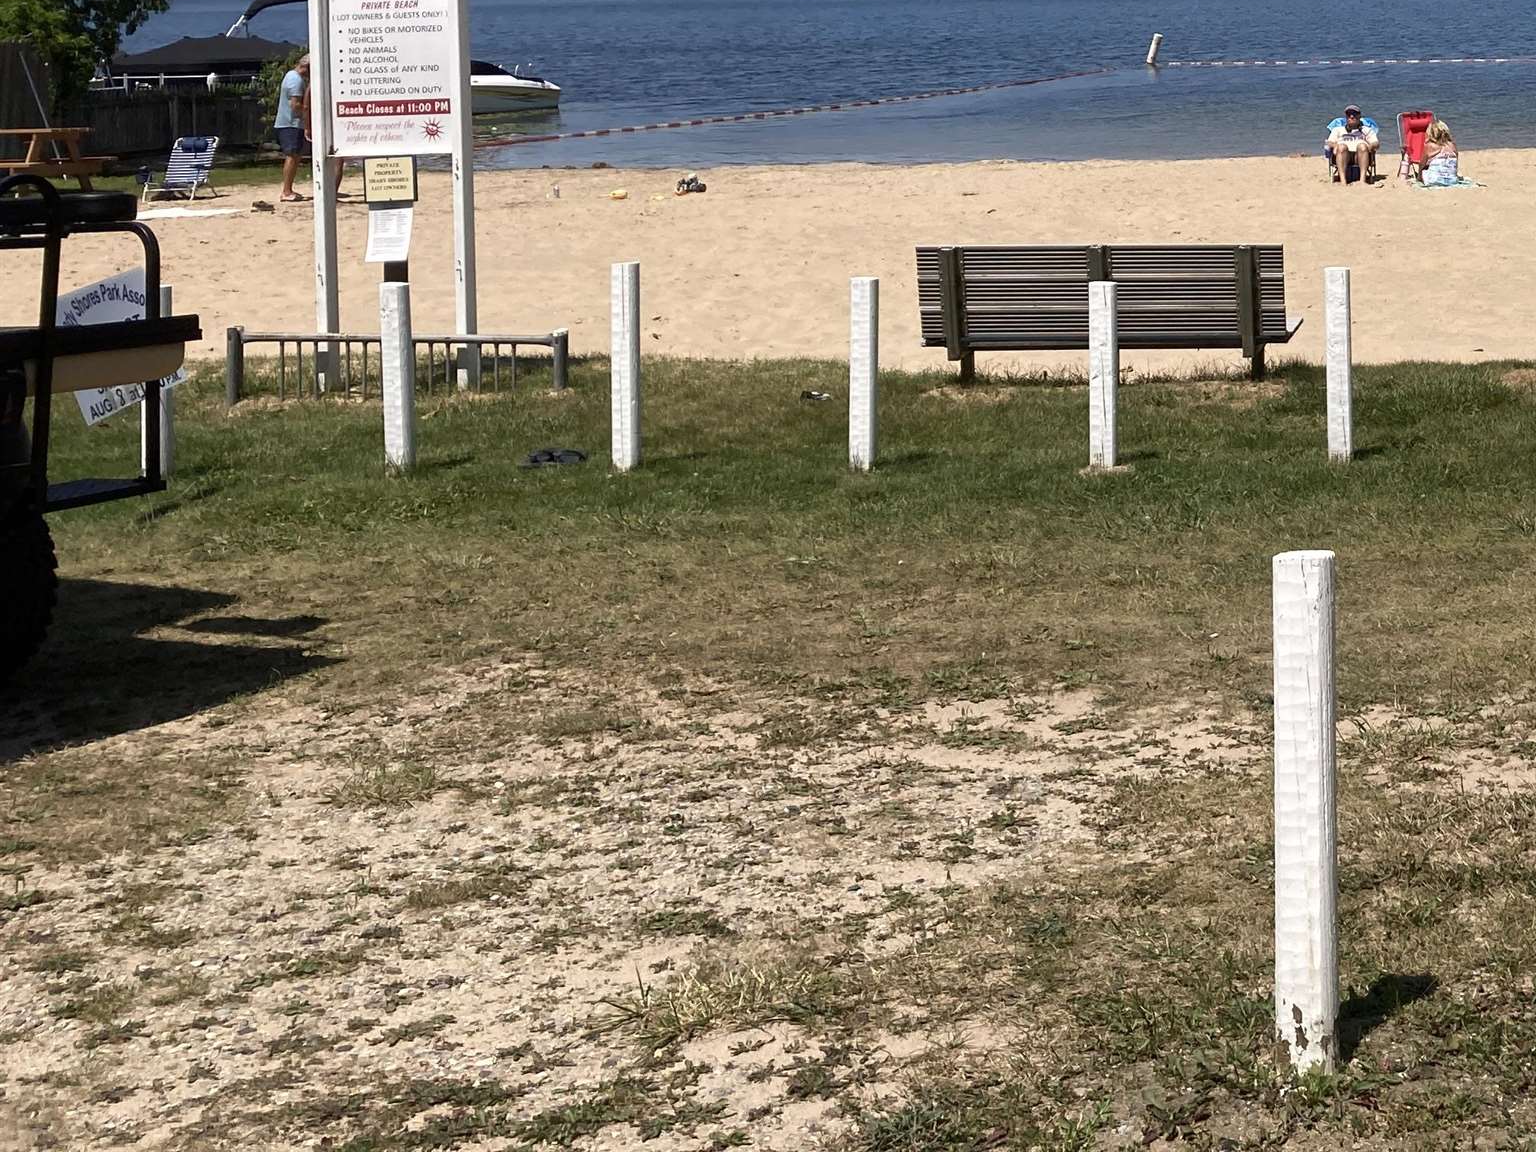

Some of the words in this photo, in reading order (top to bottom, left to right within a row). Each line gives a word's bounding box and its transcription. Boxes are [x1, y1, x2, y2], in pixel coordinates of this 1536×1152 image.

[361, 1, 391, 10] PRIVATE
[394, 0, 419, 9] BEACH
[352, 13, 383, 21] OWNERS
[392, 11, 420, 19] GUESTS
[362, 27, 383, 35] BIKES
[398, 25, 443, 33] MOTORIZED
[348, 36, 384, 44] VEHICLES
[348, 47, 360, 55] NO
[363, 46, 398, 54] ANIMALS
[363, 56, 398, 64] ALCOHOL
[364, 66, 388, 74] GLASS
[401, 65, 418, 73] ANY
[421, 64, 440, 72] KIND
[364, 77, 401, 85] LITTERING
[364, 87, 406, 95] LIFEGUARD
[422, 86, 442, 94] DUTY
[338, 104, 364, 115] Beach
[366, 103, 394, 114] Closes
[396, 104, 405, 113] at
[407, 103, 432, 113] 11:00
[434, 101, 449, 112] PM
[71, 290, 101, 317] Shores
[99, 283, 122, 302] Park
[121, 284, 146, 306] Asso
[88, 398, 113, 420] AUG
